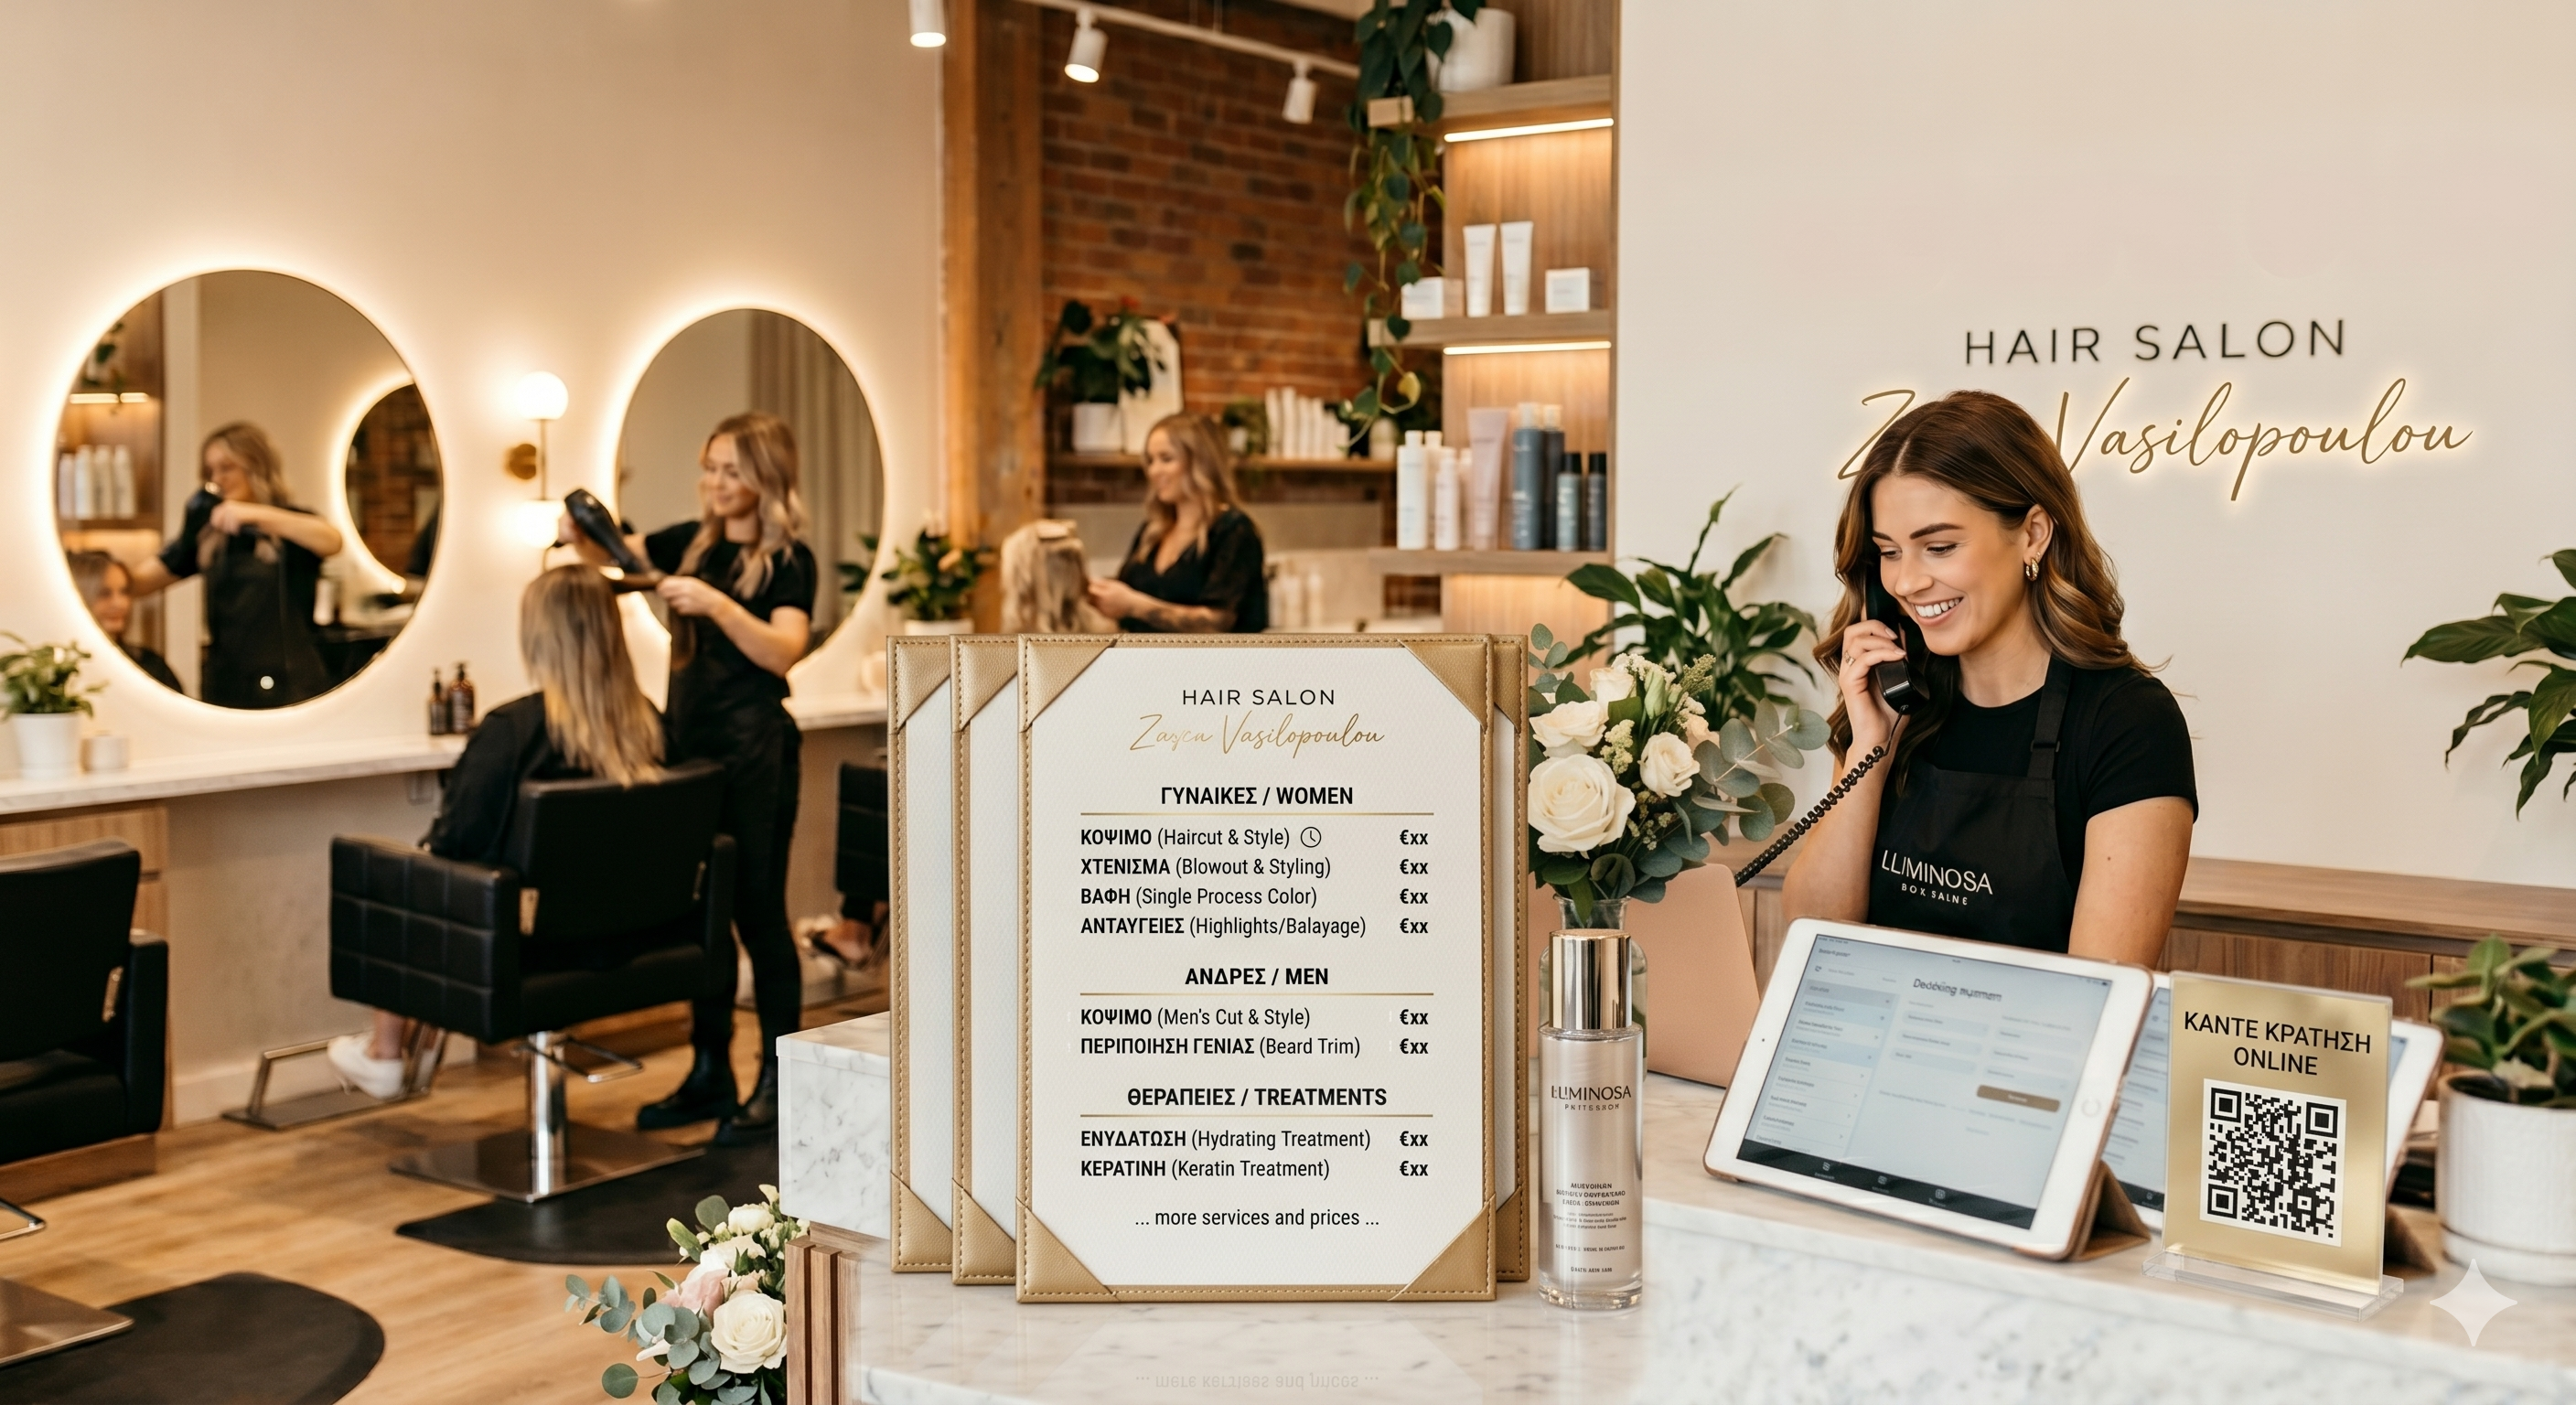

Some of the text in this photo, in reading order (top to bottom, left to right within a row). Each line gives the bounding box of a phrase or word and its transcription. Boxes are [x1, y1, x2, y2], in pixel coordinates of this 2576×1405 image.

[1965, 318, 2345, 365] HAIR SALON
[2055, 376, 2474, 502] Vasilopoulou
[1183, 689, 1335, 706] HAIR SALON
[1222, 710, 1385, 759] Vasilopoulou
[1161, 787, 1353, 807] ΓΥΝΑΙΚΕΣ / WOMEN
[1080, 827, 1429, 850] ΚΟΨΙΜΟ (Haircut & Style) €xx
[1080, 856, 1429, 879] ΧΤΕΝΙΣΜΑ (Blowout & Styling) €xx
[1080, 886, 1429, 909] ΒΑΦΗ (Single Process Color) €xx
[1902, 883, 1927, 896] BOX
[1080, 916, 1429, 938] ΑΝΤΑΥΓΕΙΕΣ (Highlights/Balayage) €xx
[1185, 968, 1328, 986] ΑΝΔΡΕΣ / MEN
[1080, 1007, 1429, 1030] ΚΟΨΙΜΟ (Men's Cut & Style) €xx
[2184, 1011, 2371, 1054] ΚΑΝΤΕ ΚΡΑΤΗΣΗ
[1080, 1036, 1429, 1059] ΠΕΡΙΠΟΙΗΣΗ ΓΕΝΙΑΣ (Beard Trim) €xx
[2234, 1046, 2318, 1076] ONLINE
[1127, 1088, 1387, 1107] ΘΕΡΑΠΕΙΕΣ / TREATMENTS
[1081, 1129, 1429, 1152] ΕΝΥΔΑΤΩΣΗ (Hydrating Treatment) €xx
[1081, 1158, 1429, 1181] ΚΕΡΑΤΙΝΗ (Keratin Treatment) €xx
[1155, 1212, 1197, 1226] more
[1202, 1208, 1270, 1226] services
[1274, 1208, 1304, 1226] and
[1310, 1208, 1360, 1230] prices
